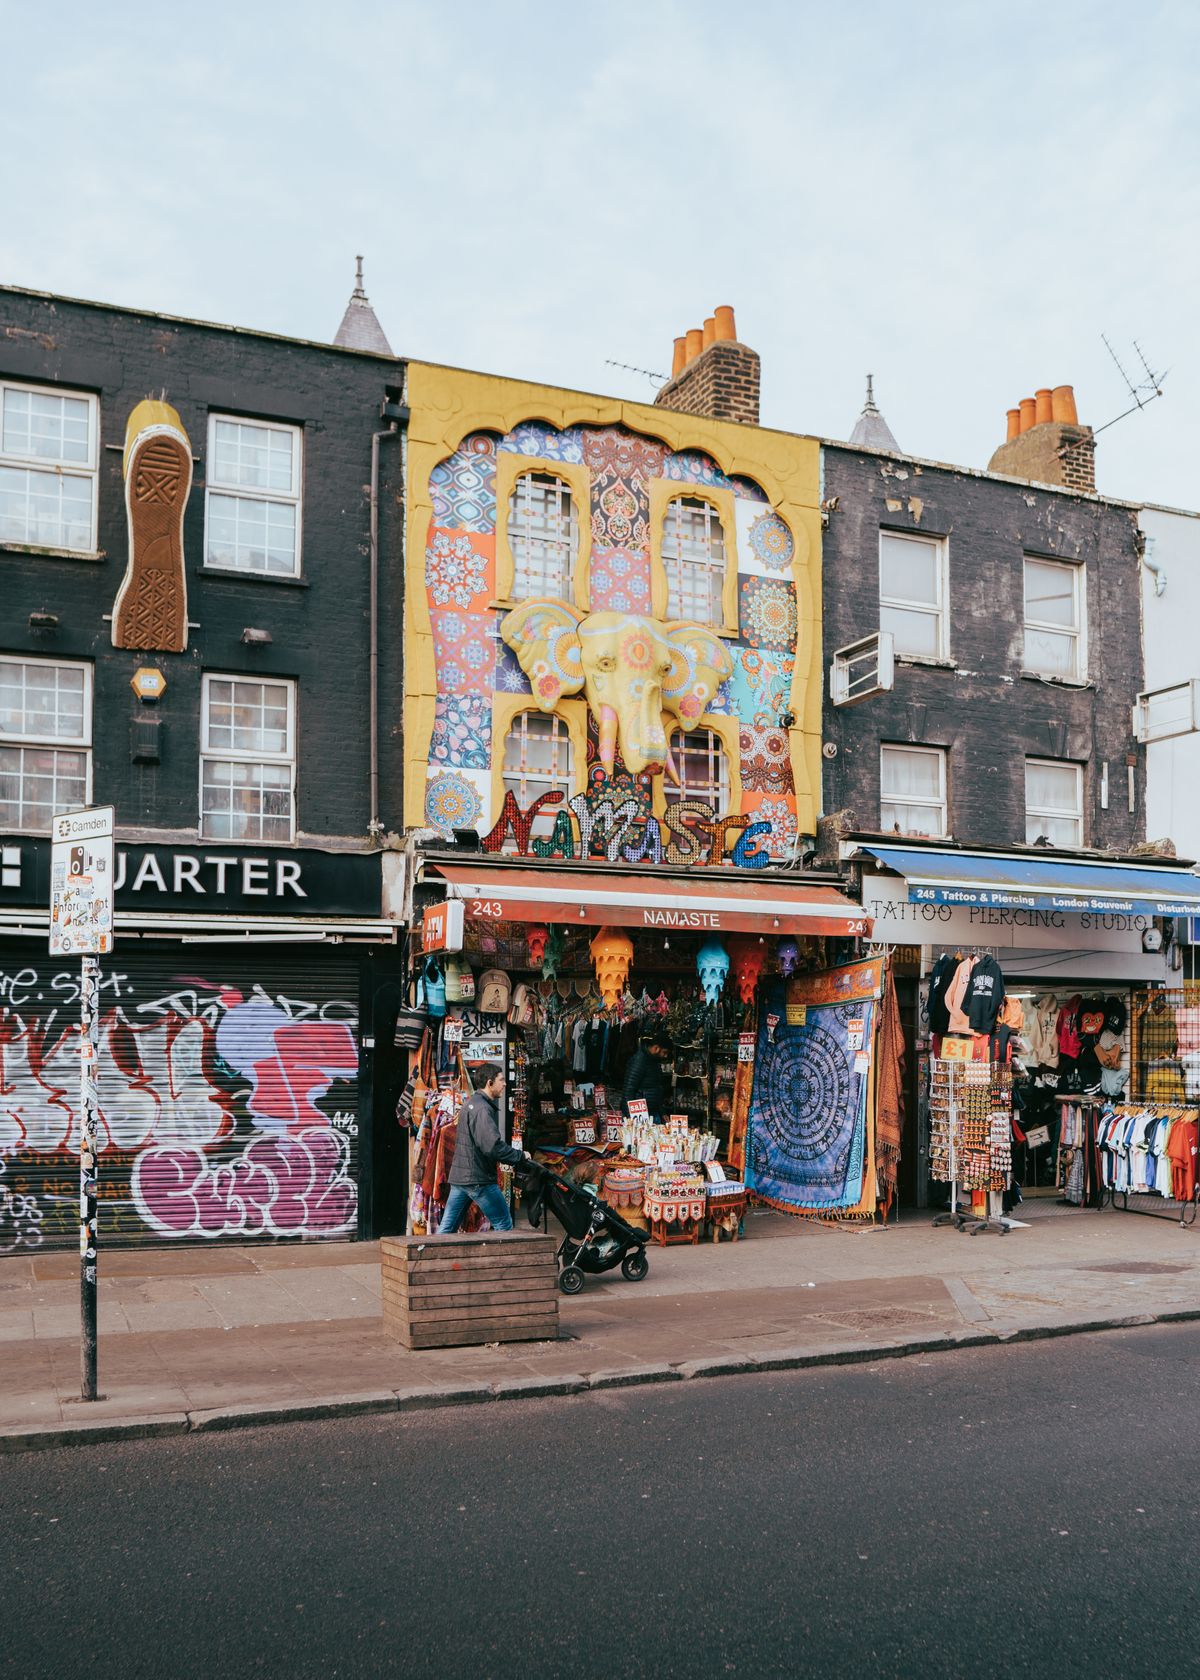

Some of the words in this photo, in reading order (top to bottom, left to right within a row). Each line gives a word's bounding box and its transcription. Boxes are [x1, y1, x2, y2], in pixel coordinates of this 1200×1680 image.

[71, 819, 107, 832] Camden
[114, 852, 308, 897] ARTER
[917, 889, 936, 899] 245
[942, 890, 977, 902] Tattoo
[979, 892, 988, 902] &
[991, 893, 1035, 906] Piercing
[1052, 897, 1089, 908] London
[1090, 900, 1133, 911] Souvenir
[473, 901, 503, 917] 243
[643, 910, 720, 927] NAMASTE
[871, 900, 952, 922] TATTOO
[969, 906, 1066, 928] PIERCING
[1080, 911, 1147, 932] STUDIO
[426, 915, 444, 942] ATM
[848, 1021, 863, 1031] sale
[740, 1035, 754, 1044] sale
[945, 1040, 968, 1057] £1
[630, 1102, 647, 1112] sale
